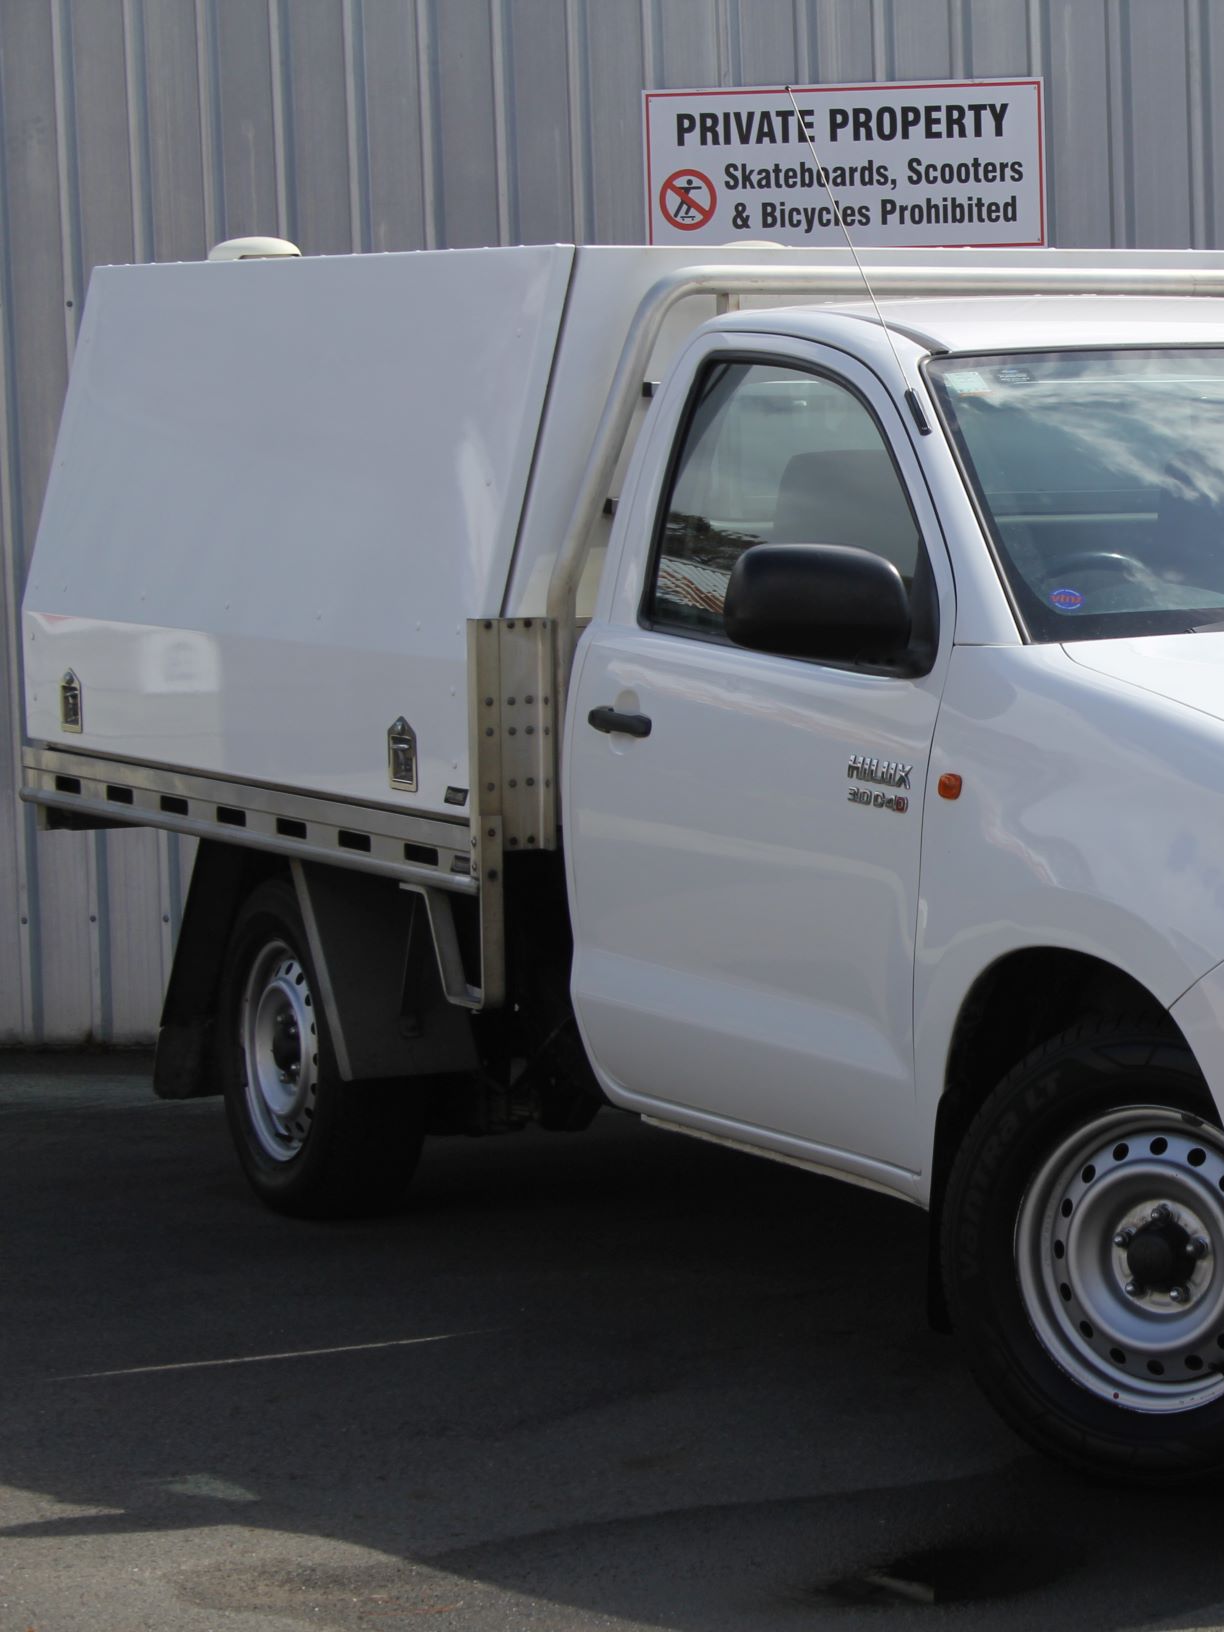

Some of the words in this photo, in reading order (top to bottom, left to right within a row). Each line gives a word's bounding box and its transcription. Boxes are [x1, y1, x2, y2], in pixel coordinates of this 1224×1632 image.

[676, 109, 815, 146] PRIVATE
[829, 103, 1009, 142] PROPERTY
[724, 159, 897, 190] Skateboards,
[907, 157, 1023, 186] Scooters
[731, 202, 750, 229] &
[761, 200, 871, 234] Bicycles
[881, 195, 1017, 225] Prohibited
[847, 754, 913, 790] HILUX
